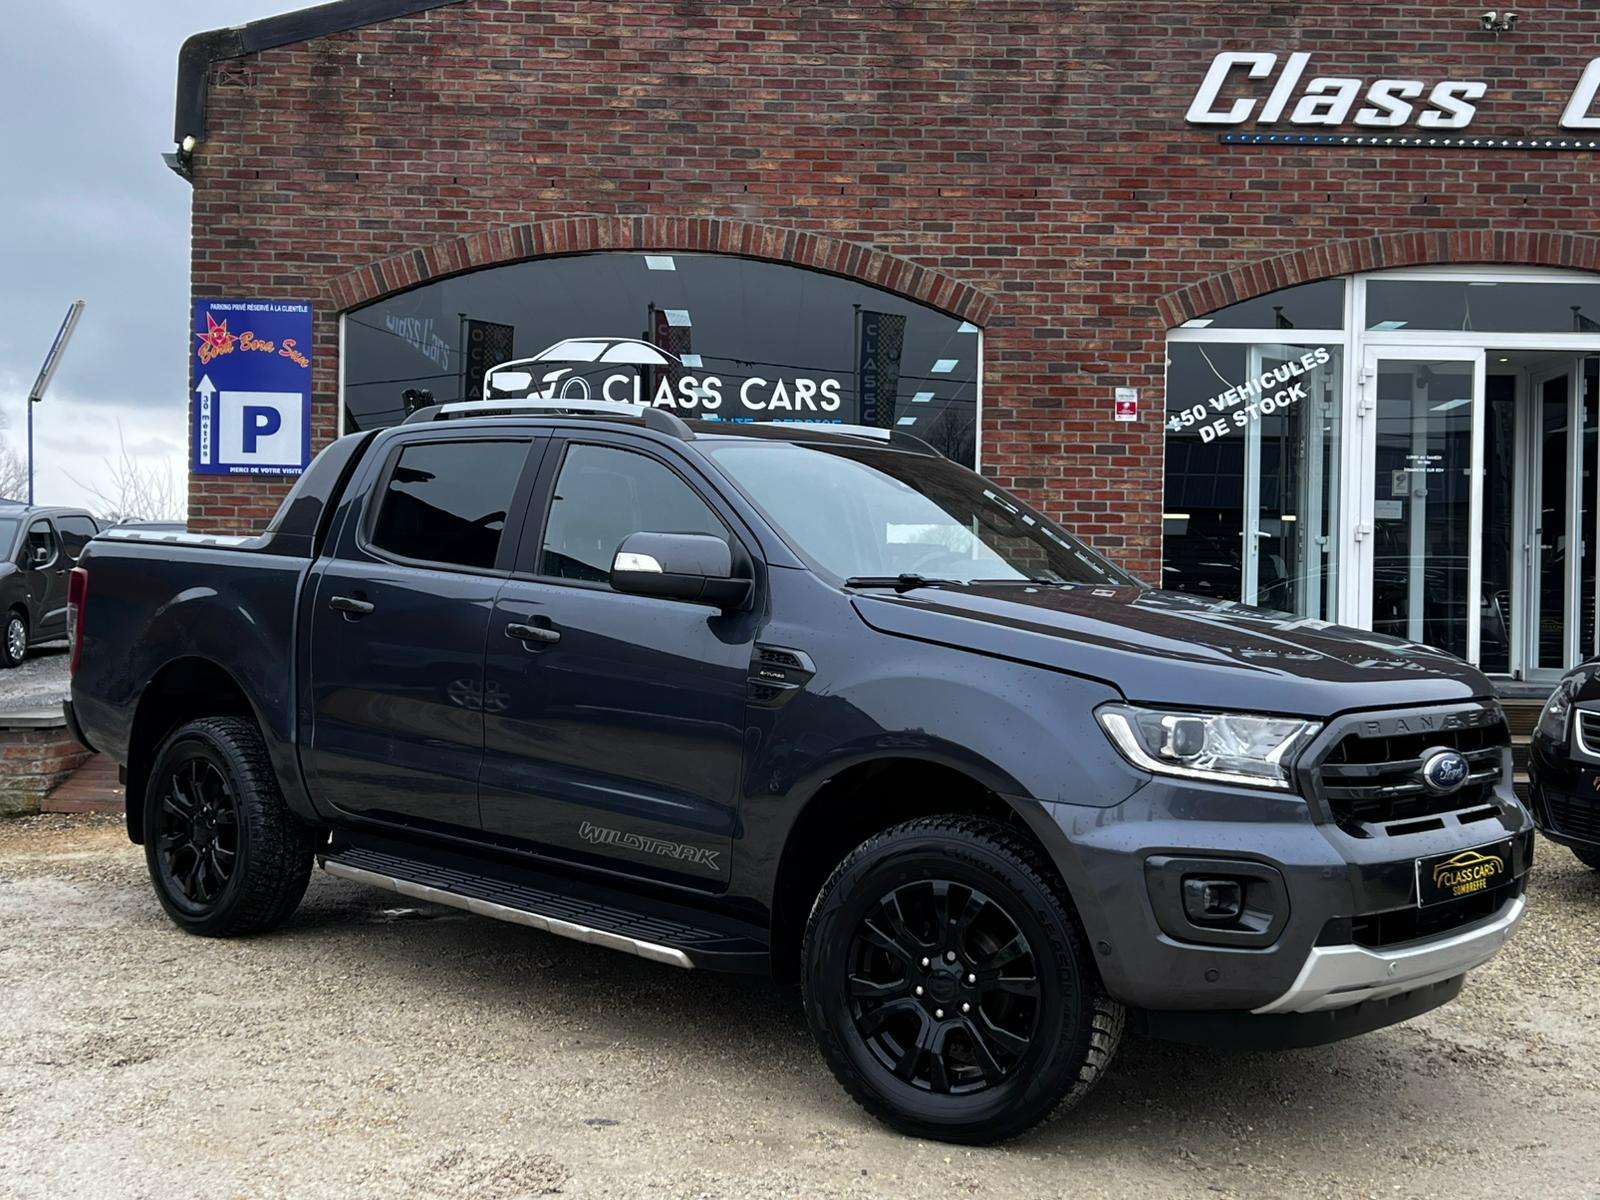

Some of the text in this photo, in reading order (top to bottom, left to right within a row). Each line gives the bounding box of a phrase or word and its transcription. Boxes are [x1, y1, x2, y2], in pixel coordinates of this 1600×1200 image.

[1185, 52, 1488, 129] Class
[239, 331, 275, 353] Bora
[602, 374, 841, 412] CLASS CARS
[1209, 347, 1330, 412] VEHICULES
[242, 405, 281, 453] P
[1199, 381, 1307, 444] DE STOCK
[1364, 708, 1500, 736] RANGER
[578, 820, 721, 871] WILDTRAK
[1444, 862, 1495, 886] CLASS CARS
